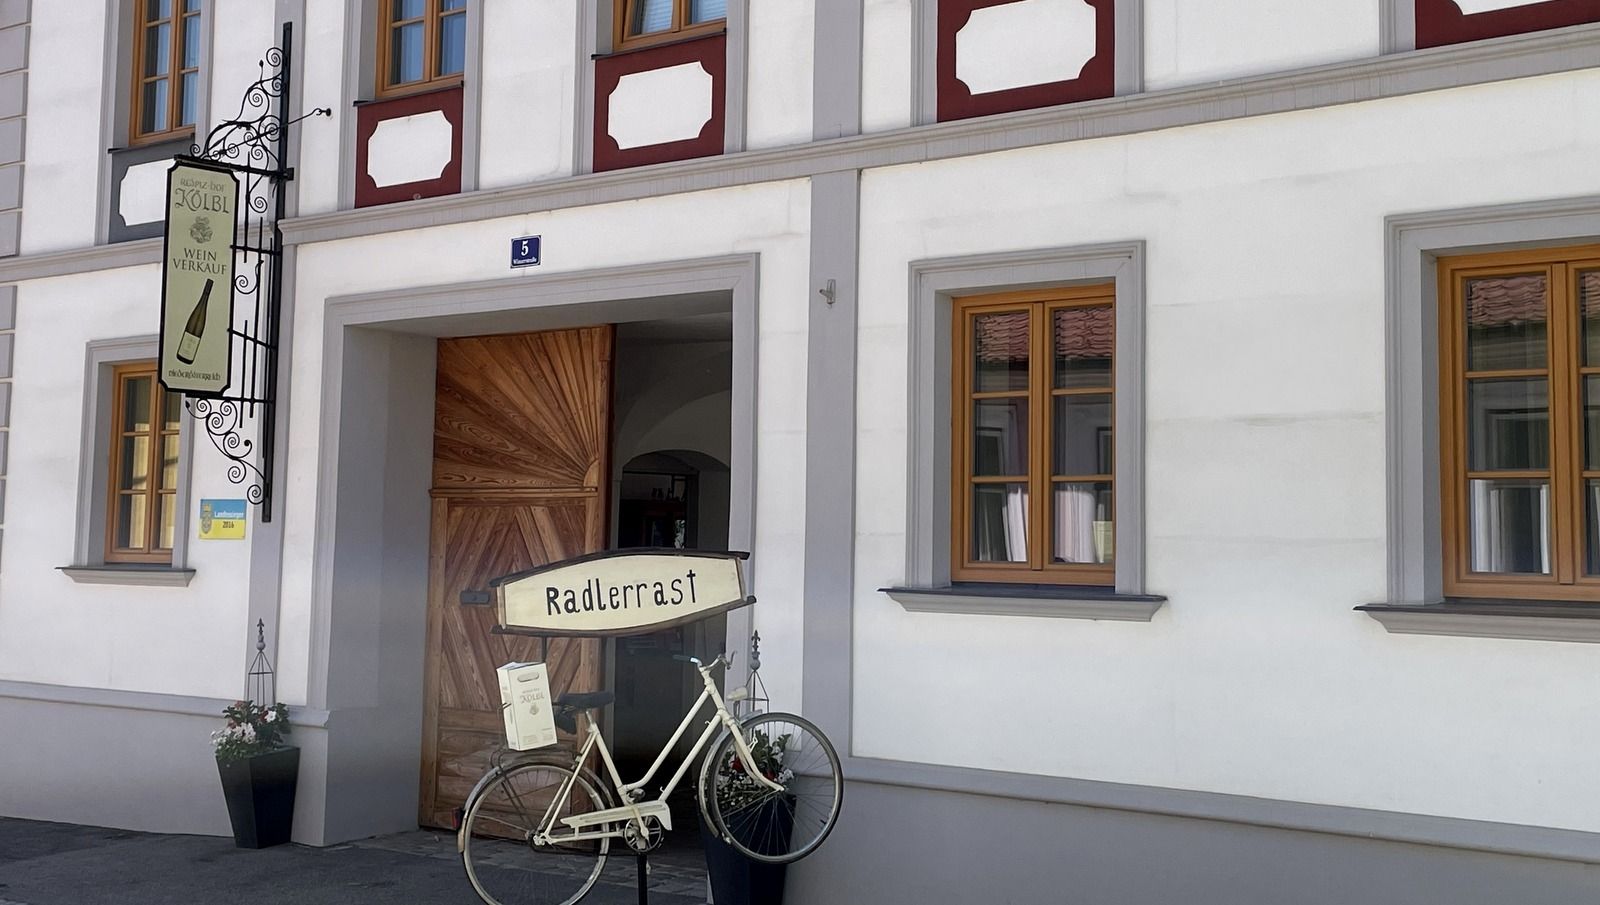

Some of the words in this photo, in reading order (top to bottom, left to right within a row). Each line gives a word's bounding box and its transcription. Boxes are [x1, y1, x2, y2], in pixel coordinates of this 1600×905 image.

[175, 187, 230, 214] KÖLBL
[184, 247, 217, 262] WEIN
[521, 240, 529, 256] 5
[173, 257, 227, 275] VERKAUF
[546, 569, 696, 616] Radlerrast
